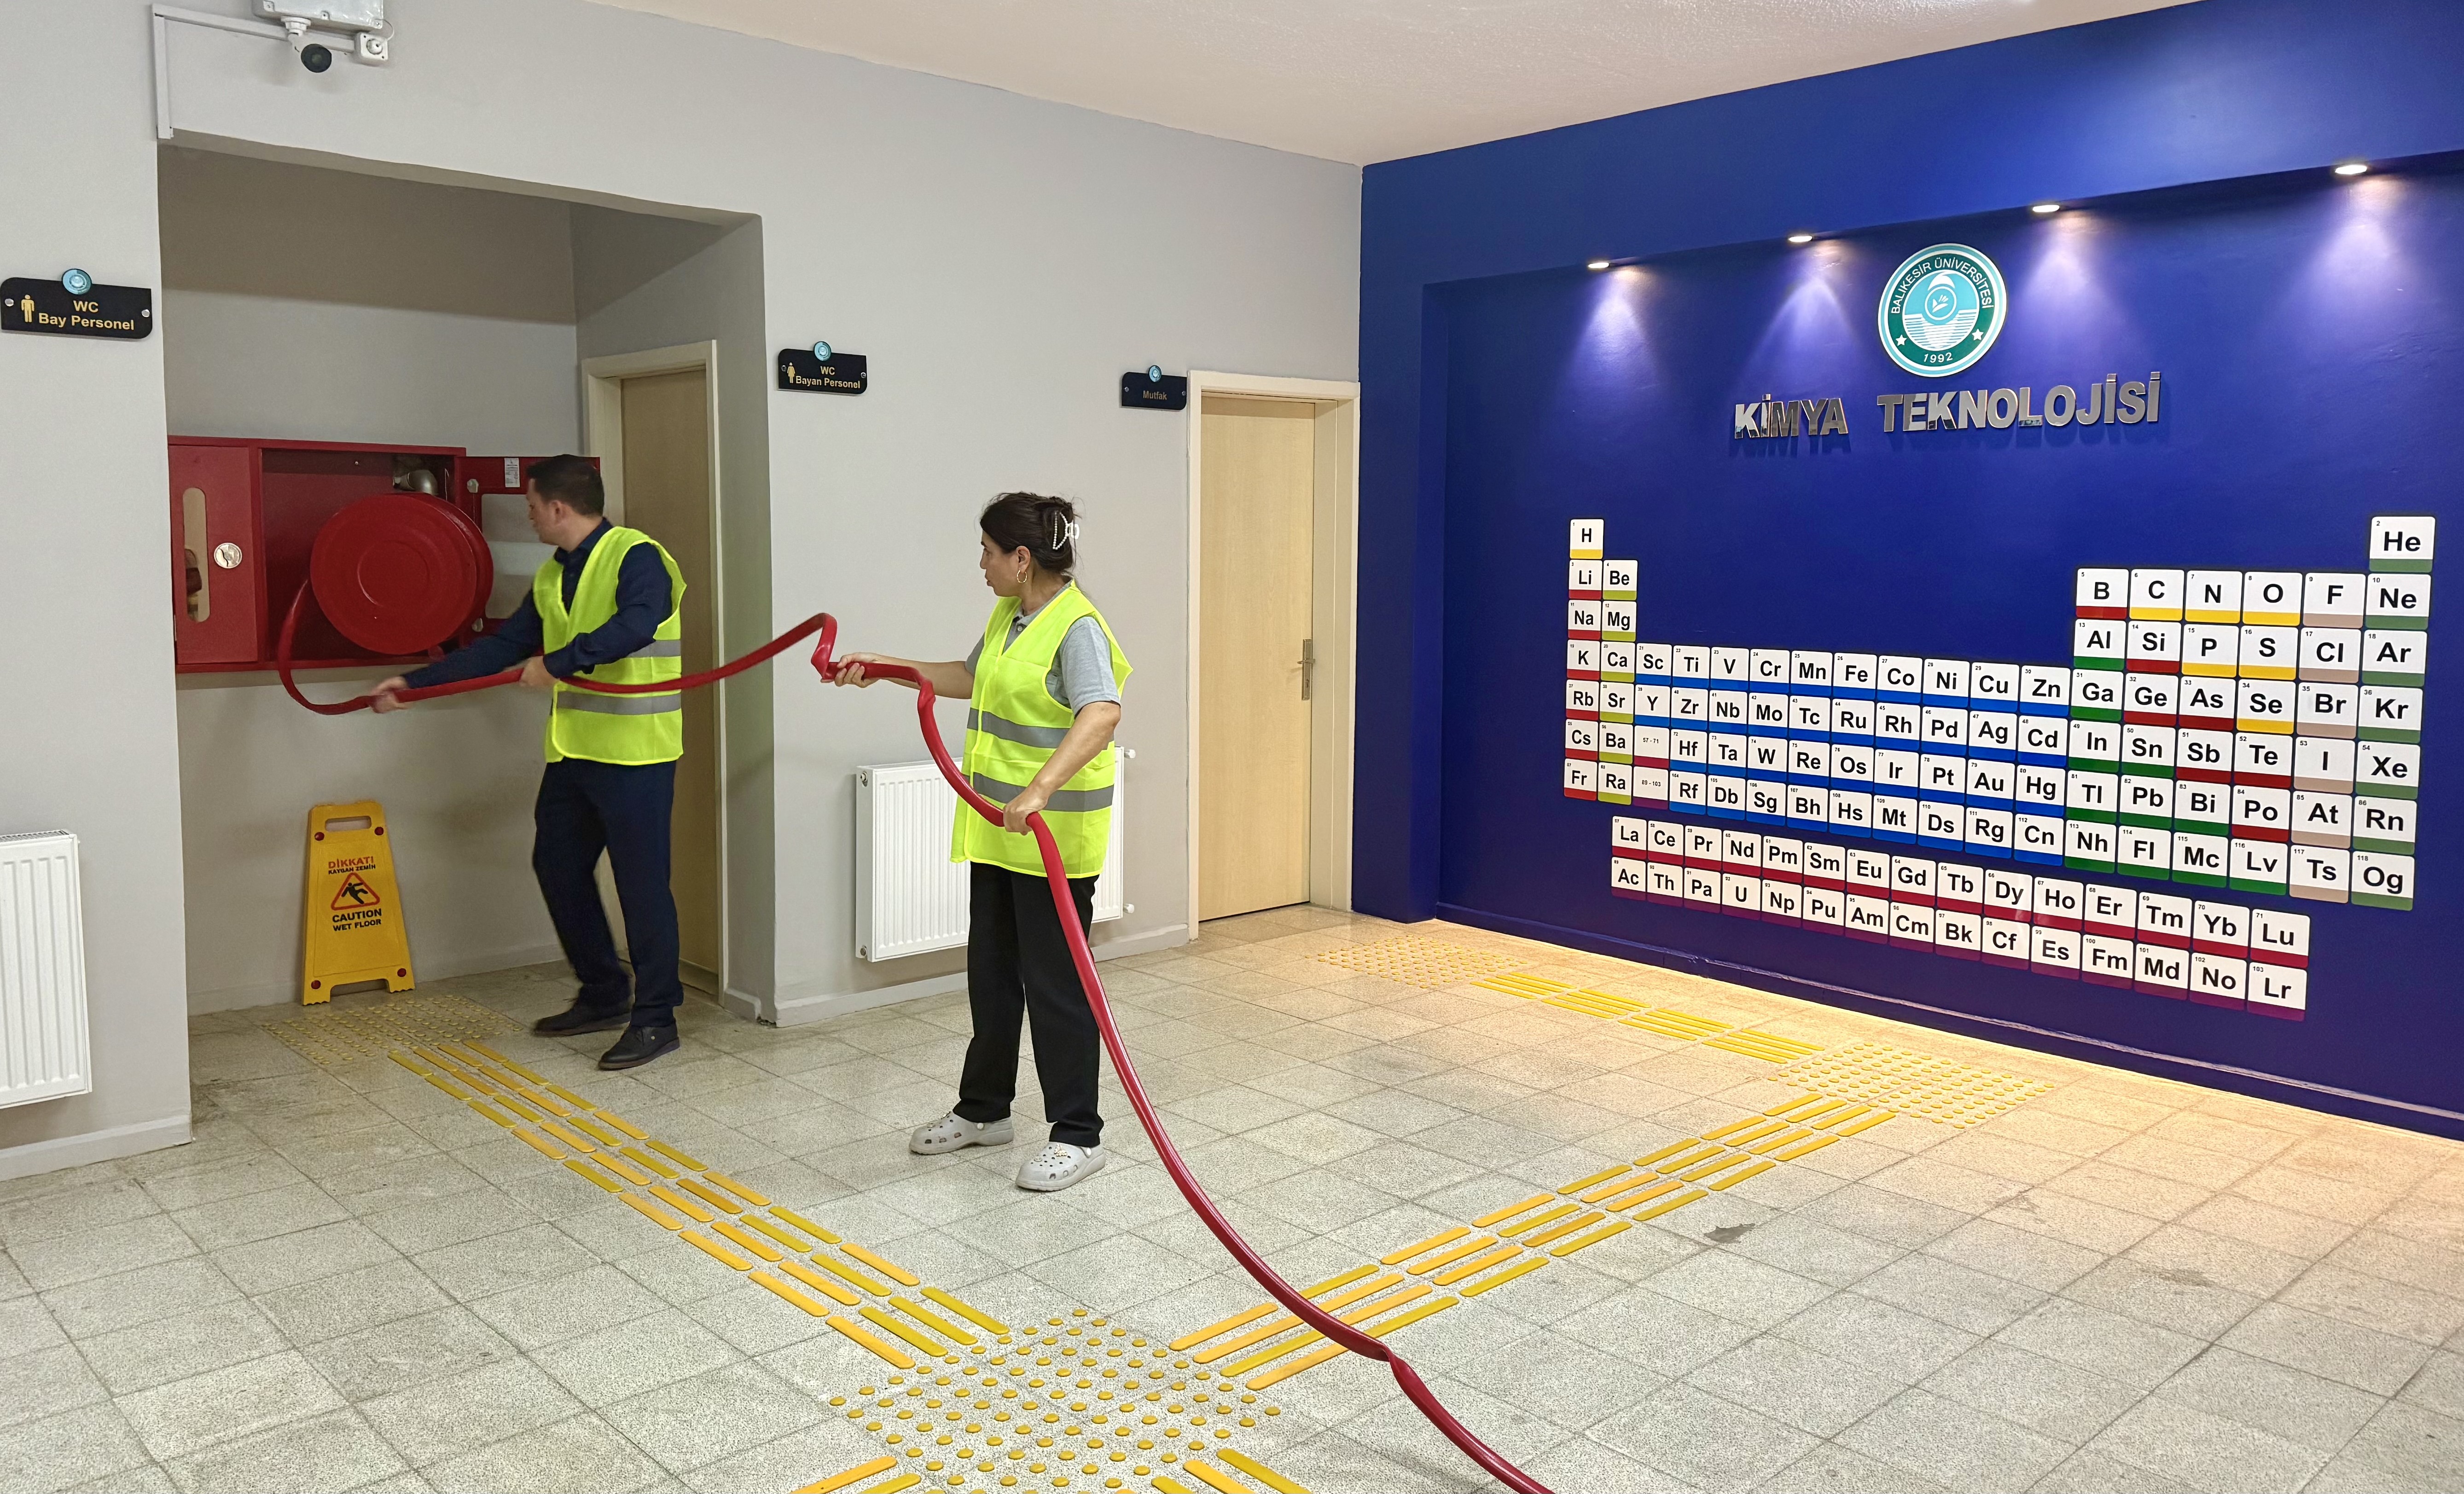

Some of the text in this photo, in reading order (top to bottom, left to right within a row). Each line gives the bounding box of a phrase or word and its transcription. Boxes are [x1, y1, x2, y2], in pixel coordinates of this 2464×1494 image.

[1891, 257, 1994, 314] BALIKESİR ÜNİVERSİTESİ
[73, 300, 99, 313] WC
[39, 313, 134, 330] Bay Personel
[1924, 352, 1953, 363] 1992
[820, 366, 835, 375] WC
[796, 376, 860, 388] Bayan Personel
[1143, 390, 1167, 400] Mutfak
[1735, 371, 2161, 439] KİMYA TEKNOLOJİSİ
[1581, 528, 1592, 543] H
[2384, 531, 2421, 552] He
[1579, 570, 1592, 585] Li
[1610, 570, 1630, 585] Be
[2094, 582, 2110, 600] B
[2148, 580, 2165, 599] C
[2204, 584, 2221, 603] N
[2263, 584, 2284, 603] O
[2327, 585, 2343, 604] F
[2380, 588, 2417, 609] Ne
[1575, 610, 1594, 625] Na
[1608, 611, 1630, 631] Mg
[2086, 630, 2111, 649] Al
[2142, 632, 2165, 651] Si
[2201, 638, 2217, 657] P
[2259, 637, 2276, 657] S
[1578, 650, 1589, 665] K
[1607, 652, 1627, 667] Ca
[1643, 654, 1663, 670] Sc
[2316, 642, 2344, 663] Cl
[2376, 642, 2412, 663] Ar
[1684, 656, 1699, 672] Ti
[1723, 658, 1736, 674] V
[1760, 660, 1782, 677] Cr
[1799, 662, 1826, 680] Mn
[1845, 665, 1868, 683] Fe
[1887, 668, 1915, 686] Co
[1936, 672, 1957, 689] Ni
[1979, 675, 2008, 694] Cu
[2032, 678, 2060, 698] Zn
[2082, 682, 2113, 702] Ga
[1573, 690, 1593, 706] Rb
[1608, 693, 1626, 708] Sr
[1647, 695, 1658, 711] Y
[2134, 686, 2168, 706] Ge
[2190, 688, 2224, 708] As
[2249, 693, 2283, 714] Se
[2315, 693, 2348, 714] Br
[1680, 698, 1699, 715] Zr
[1716, 701, 1740, 718] Nb
[1756, 704, 1783, 722] Mo
[1799, 707, 1820, 725] Tc
[2375, 698, 2409, 719] Kr
[1841, 711, 1866, 729] Ru
[1885, 715, 1912, 734] Rh
[1931, 719, 1958, 738] Pd
[1572, 730, 1591, 745] Cs
[1606, 732, 1626, 749] Ba
[1978, 721, 2008, 744] Ag
[2028, 729, 2058, 748] Cd
[2087, 732, 2107, 751] In
[1679, 740, 1698, 757] Hf
[1718, 744, 1738, 761] Ta
[1757, 747, 1776, 764] W
[2131, 738, 2162, 758] Sn
[2187, 742, 2220, 763] Sb
[2249, 744, 2278, 765] Te
[1797, 752, 1821, 770] Re
[1840, 756, 1866, 775] Os
[1889, 762, 1903, 779] Ir
[2322, 751, 2329, 771] I
[2371, 756, 2408, 778] Xe
[1572, 770, 1587, 786] Fr
[1606, 773, 1626, 790] Ra
[1933, 767, 1954, 786] Pt
[1974, 772, 2004, 792] Au
[1679, 782, 1699, 799] Rf
[1714, 787, 1738, 804] Db
[2026, 776, 2056, 800] Hg
[2081, 784, 2102, 804] Tl
[2133, 787, 2163, 807] Pb
[1754, 792, 1777, 813] Sg
[1796, 797, 1820, 816] Bh
[1838, 802, 1863, 821] Hs
[2191, 793, 2215, 813] Bi
[2244, 799, 2278, 821] Po
[1882, 808, 1906, 827] Mt
[2307, 803, 2339, 824] At
[2366, 808, 2404, 831] Rn
[1928, 814, 1954, 833] Ds
[1976, 818, 2004, 843] Rg
[1621, 825, 1639, 842] La
[1654, 830, 1675, 847] Ce
[2024, 825, 2054, 845] Cn
[2077, 831, 2108, 852] Nh
[1694, 835, 1713, 852] Pr
[1731, 840, 1754, 858] Nd
[2133, 840, 2154, 860] Fl
[1769, 845, 1797, 865] Pm
[1810, 852, 1840, 872] Sm
[2184, 846, 2220, 868] Mc
[2247, 851, 2278, 872] Lv
[1618, 868, 1639, 885] Ac
[1857, 859, 1882, 879] Eu
[1898, 867, 1926, 886] Gd
[2307, 859, 2336, 881] Ts
[1654, 873, 1674, 891] Th
[1691, 879, 1712, 897] Pa
[1947, 873, 1974, 893] Tb
[2363, 866, 2403, 894] Og
[1736, 886, 1747, 902] U
[1996, 880, 2024, 905] Dy
[2045, 888, 2075, 909] Ho
[1770, 892, 1795, 914] Np
[1812, 899, 1836, 918] Pu
[2097, 896, 2122, 916] Er
[332, 908, 382, 922] CAUTION
[354, 919, 381, 928] FLOOR
[1851, 907, 1883, 927] Am
[2146, 905, 2183, 928] Tm
[1896, 915, 1929, 936] Cm
[1946, 922, 1972, 943] Bk
[2203, 914, 2237, 937] Yb
[2262, 923, 2294, 946] Lu
[1993, 931, 2017, 950] Cf
[2042, 939, 2069, 960] Es
[2092, 948, 2127, 971] Fm
[2144, 957, 2179, 980] Md
[2202, 967, 2236, 990] No
[2264, 977, 2292, 999] Lr
